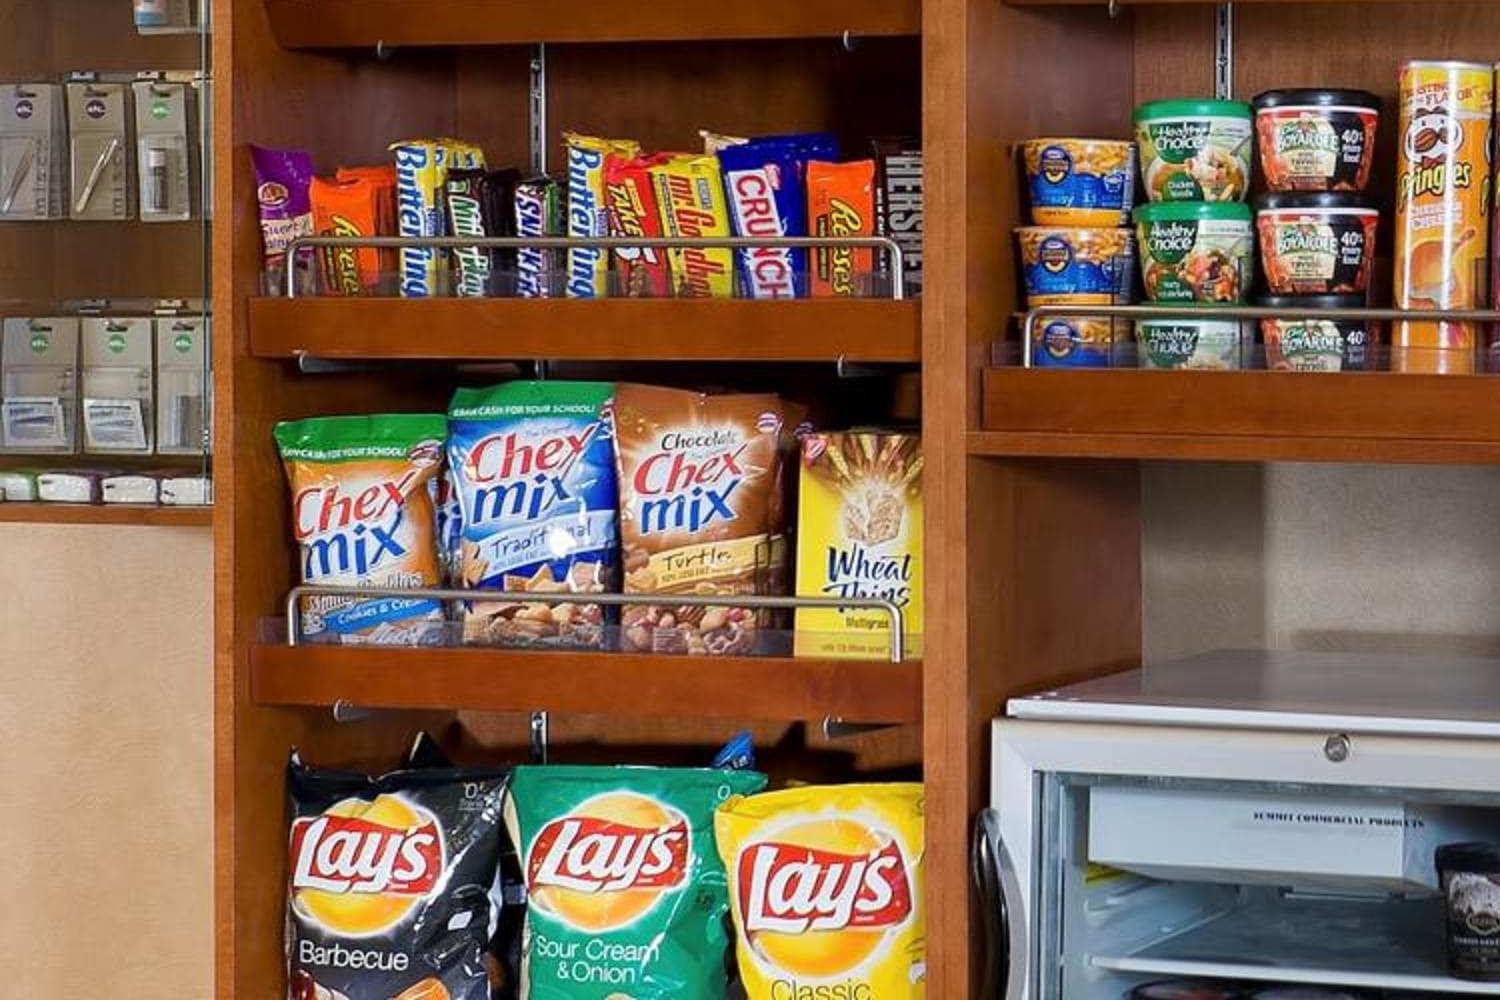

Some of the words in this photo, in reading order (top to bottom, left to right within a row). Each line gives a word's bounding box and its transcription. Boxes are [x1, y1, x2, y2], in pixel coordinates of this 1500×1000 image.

[1155, 135, 1204, 150] Choice
[1149, 235, 1193, 251] Choice
[1150, 221, 1196, 239] Healthy
[466, 421, 599, 484] Chex
[633, 443, 748, 497] Chex
[293, 471, 416, 538] Chex
[474, 472, 575, 524] mix
[639, 478, 740, 535] mix
[305, 504, 407, 579] mix
[491, 519, 593, 558] Traditnal
[828, 542, 912, 583] Wheat
[299, 939, 410, 971] Barbecue
[536, 935, 581, 960] Sour
[585, 939, 660, 963] Cream
[570, 961, 636, 985] Onion
[770, 979, 873, 1000] Classic
